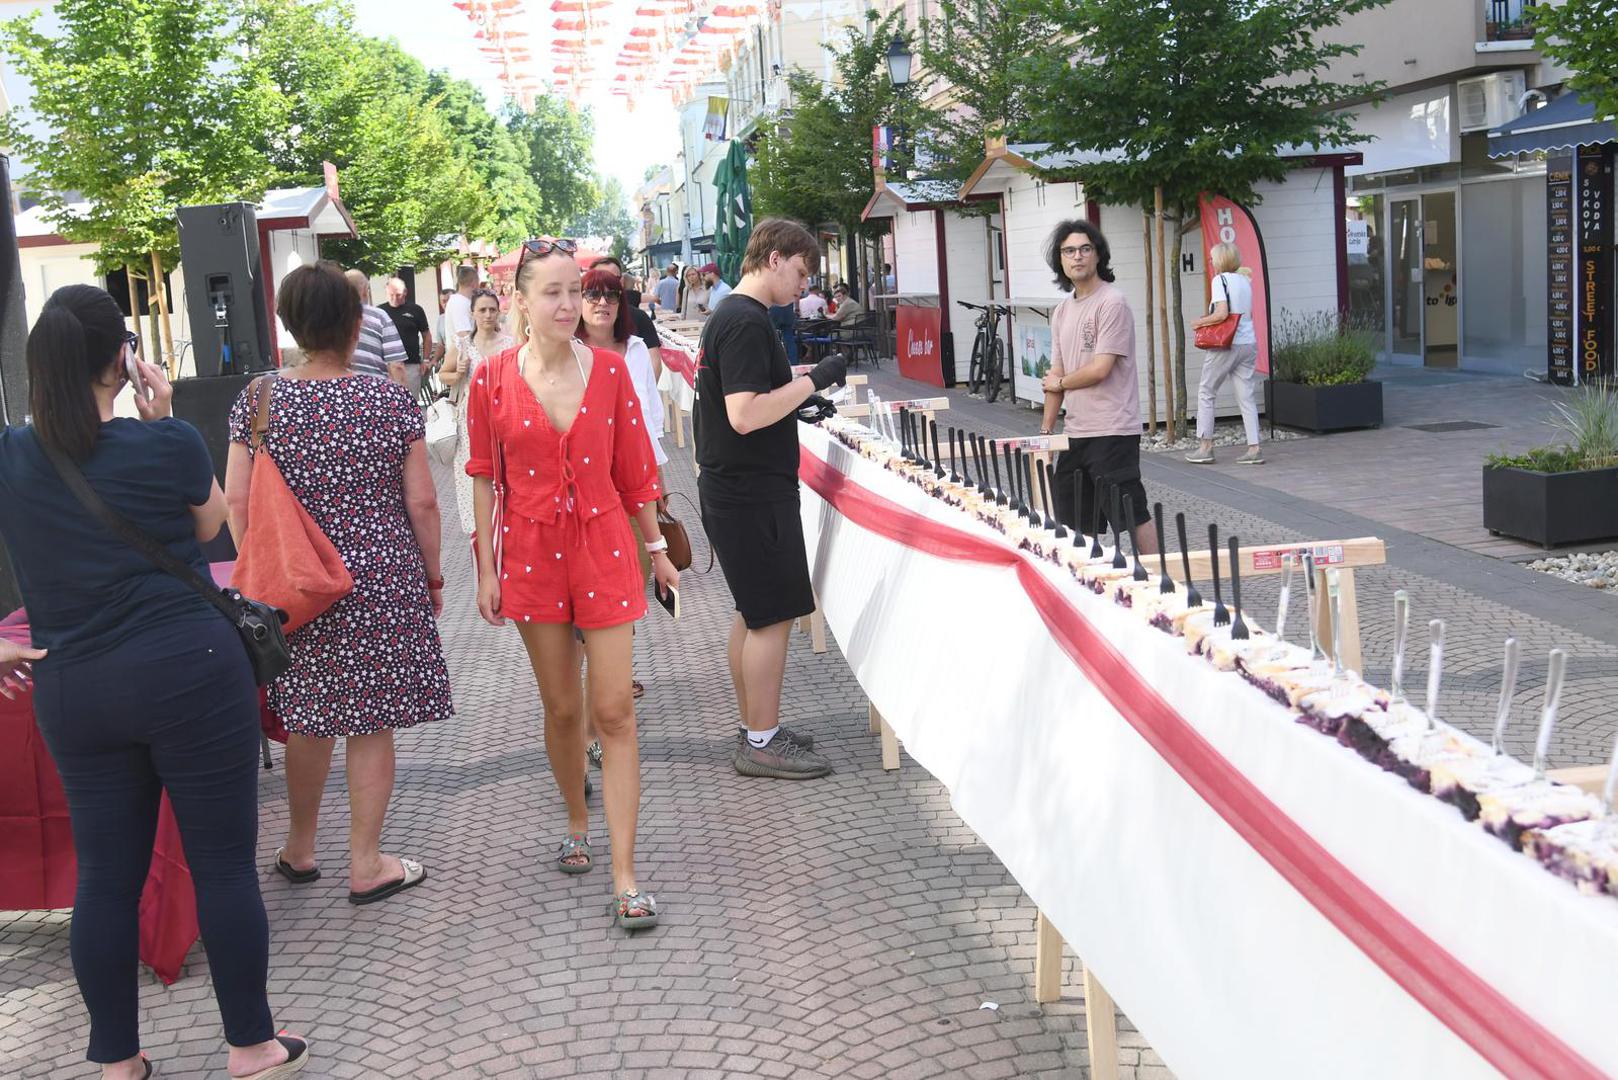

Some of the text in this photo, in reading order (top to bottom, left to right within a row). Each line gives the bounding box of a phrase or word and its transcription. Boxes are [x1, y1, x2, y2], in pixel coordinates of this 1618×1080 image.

[1182, 253, 1194, 272] H
[1585, 261, 1597, 370] STREET FOOD
